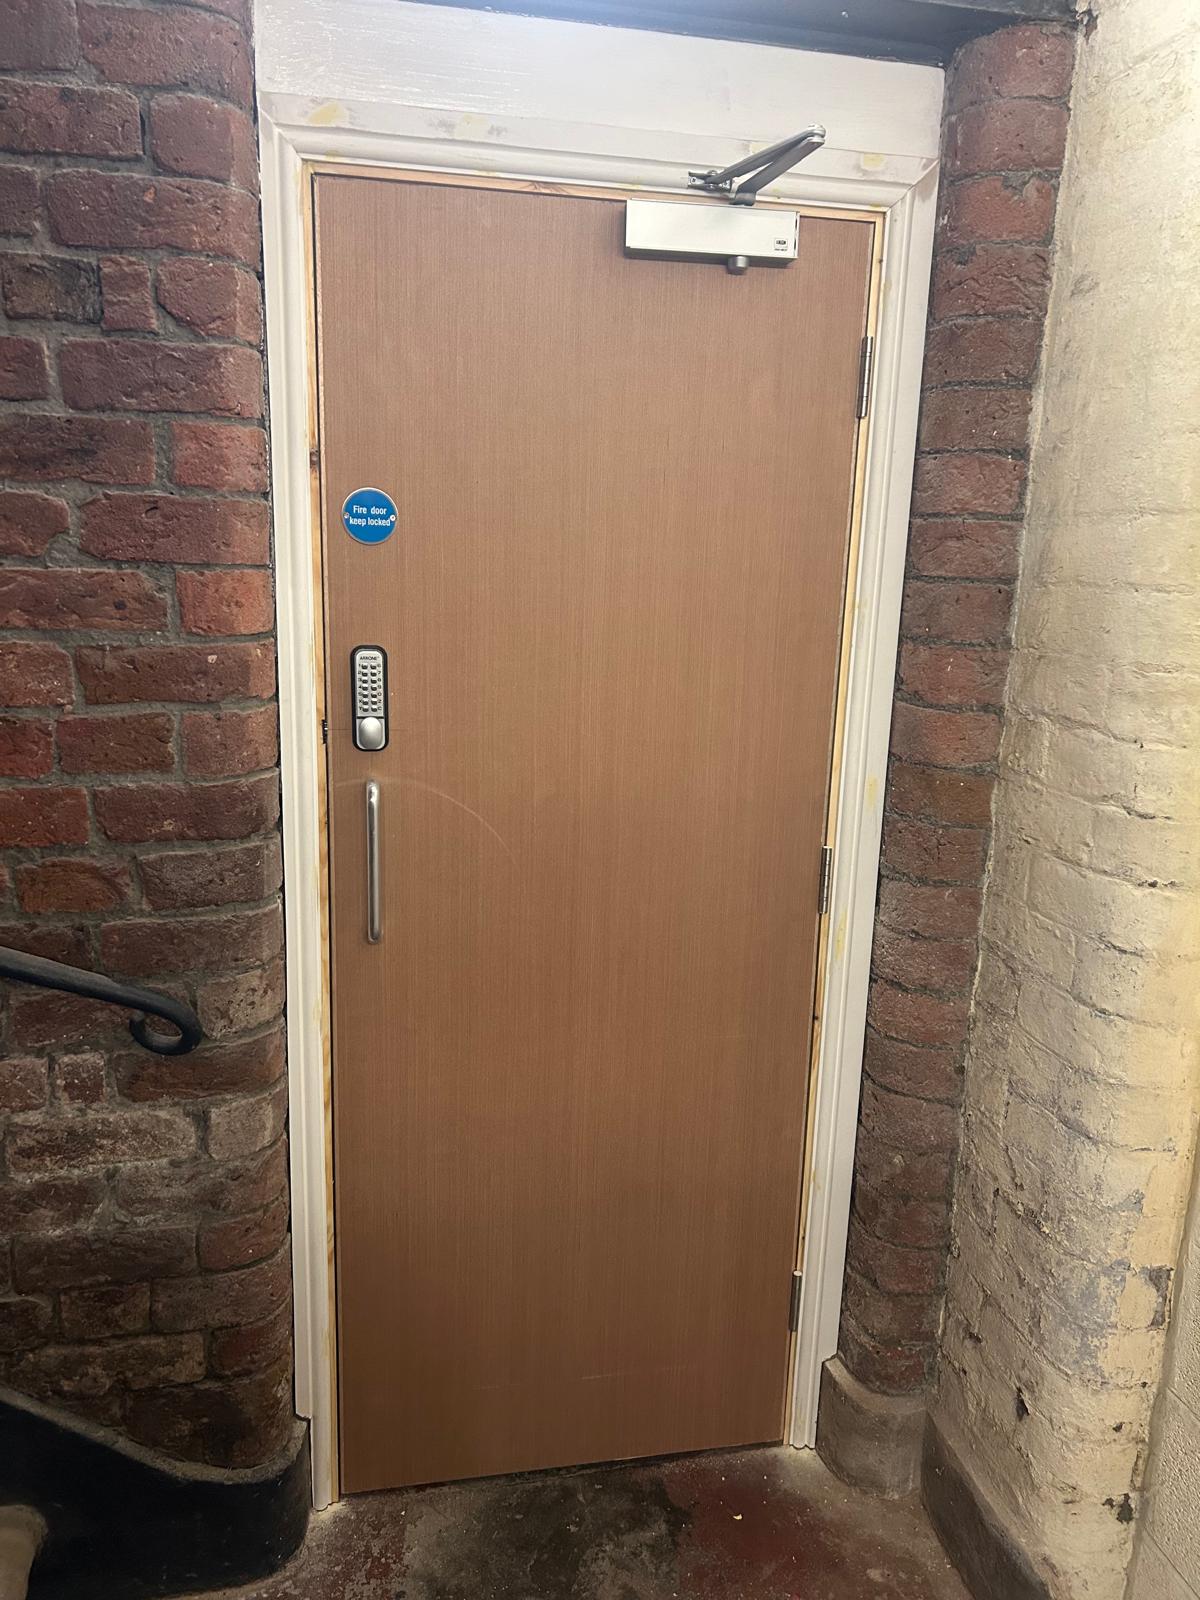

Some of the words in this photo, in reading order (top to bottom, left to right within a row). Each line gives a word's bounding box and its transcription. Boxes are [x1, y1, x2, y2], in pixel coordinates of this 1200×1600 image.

[353, 505, 367, 514] Fire
[370, 505, 387, 515] door
[349, 516, 366, 527] keep
[367, 516, 391, 526] locked
